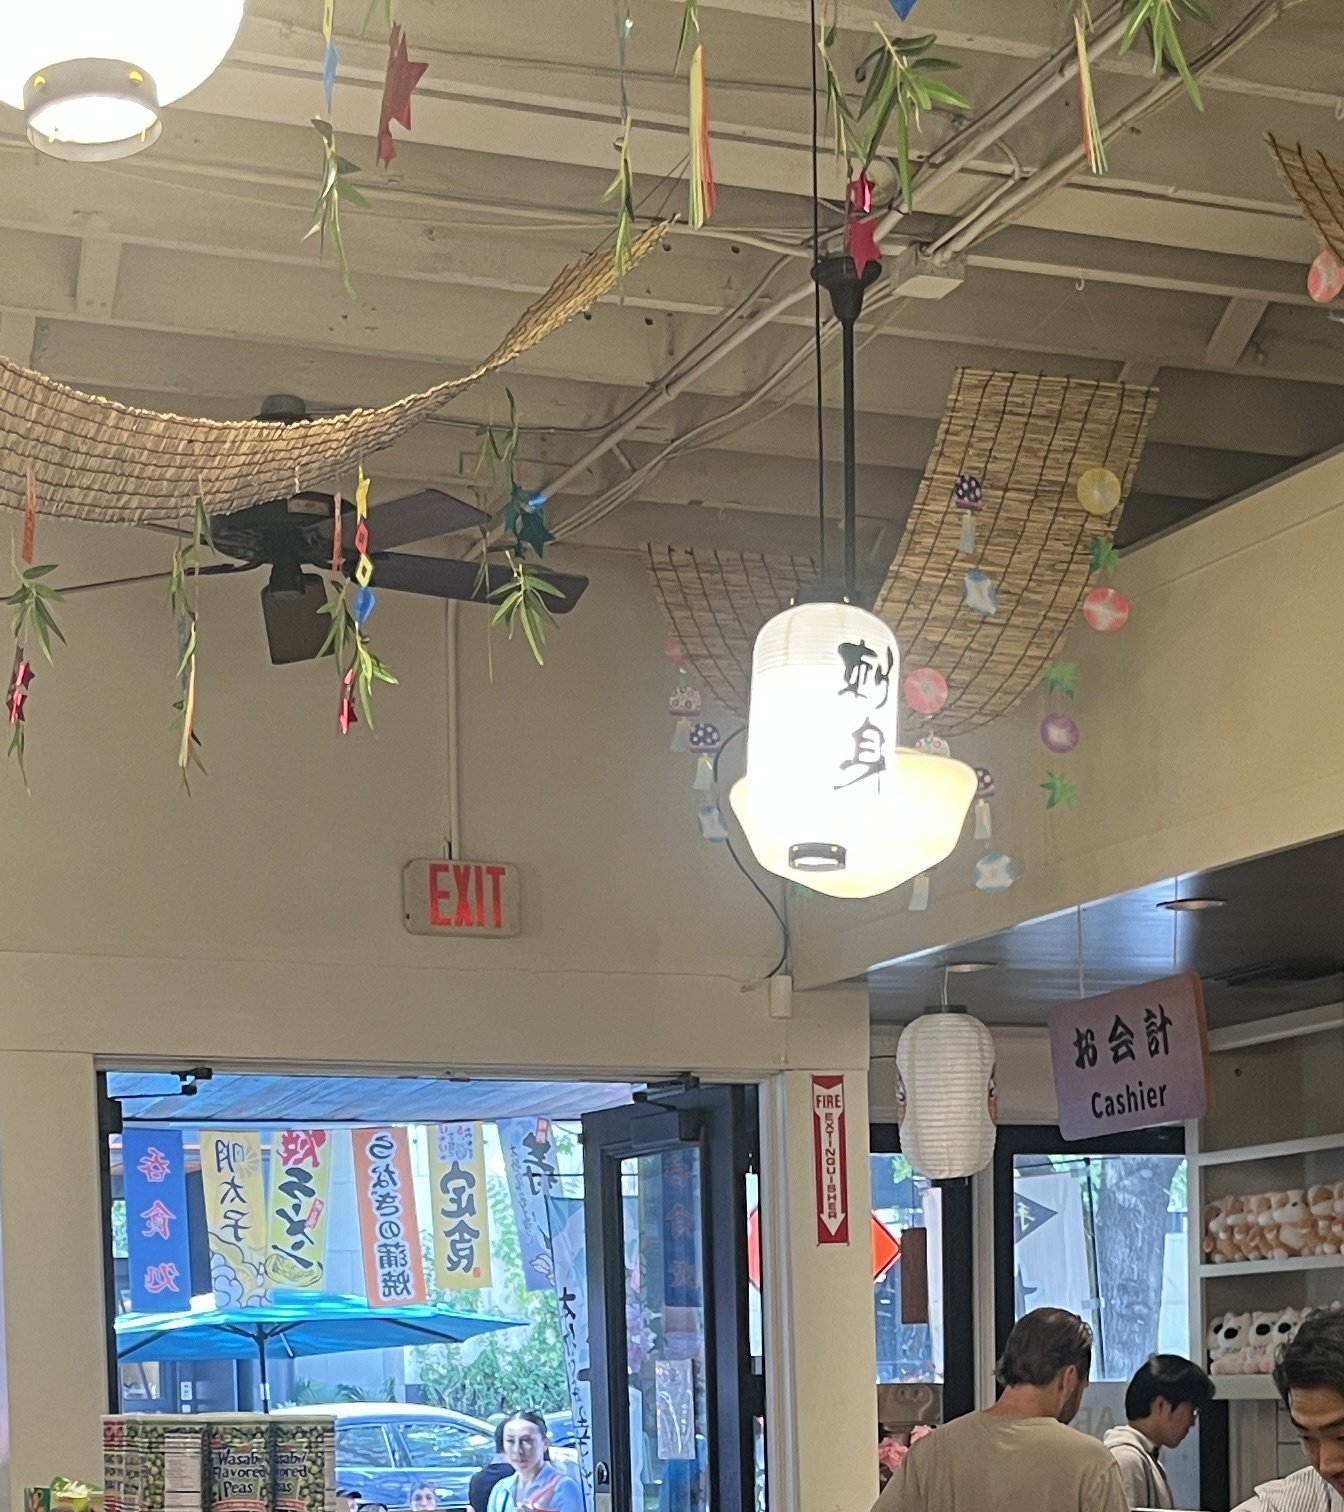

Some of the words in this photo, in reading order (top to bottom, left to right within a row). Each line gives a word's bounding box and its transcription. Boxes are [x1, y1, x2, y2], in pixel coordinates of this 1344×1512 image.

[429, 863, 506, 928] EXIT
[1072, 1003, 1174, 1070] お会計
[816, 1094, 841, 1110] FIRE
[1091, 1081, 1168, 1120] Cashier
[824, 1113, 838, 1220] EXTINGUISHER
[213, 1465, 267, 1479] Flavored
[223, 1480, 254, 1497] Peas
